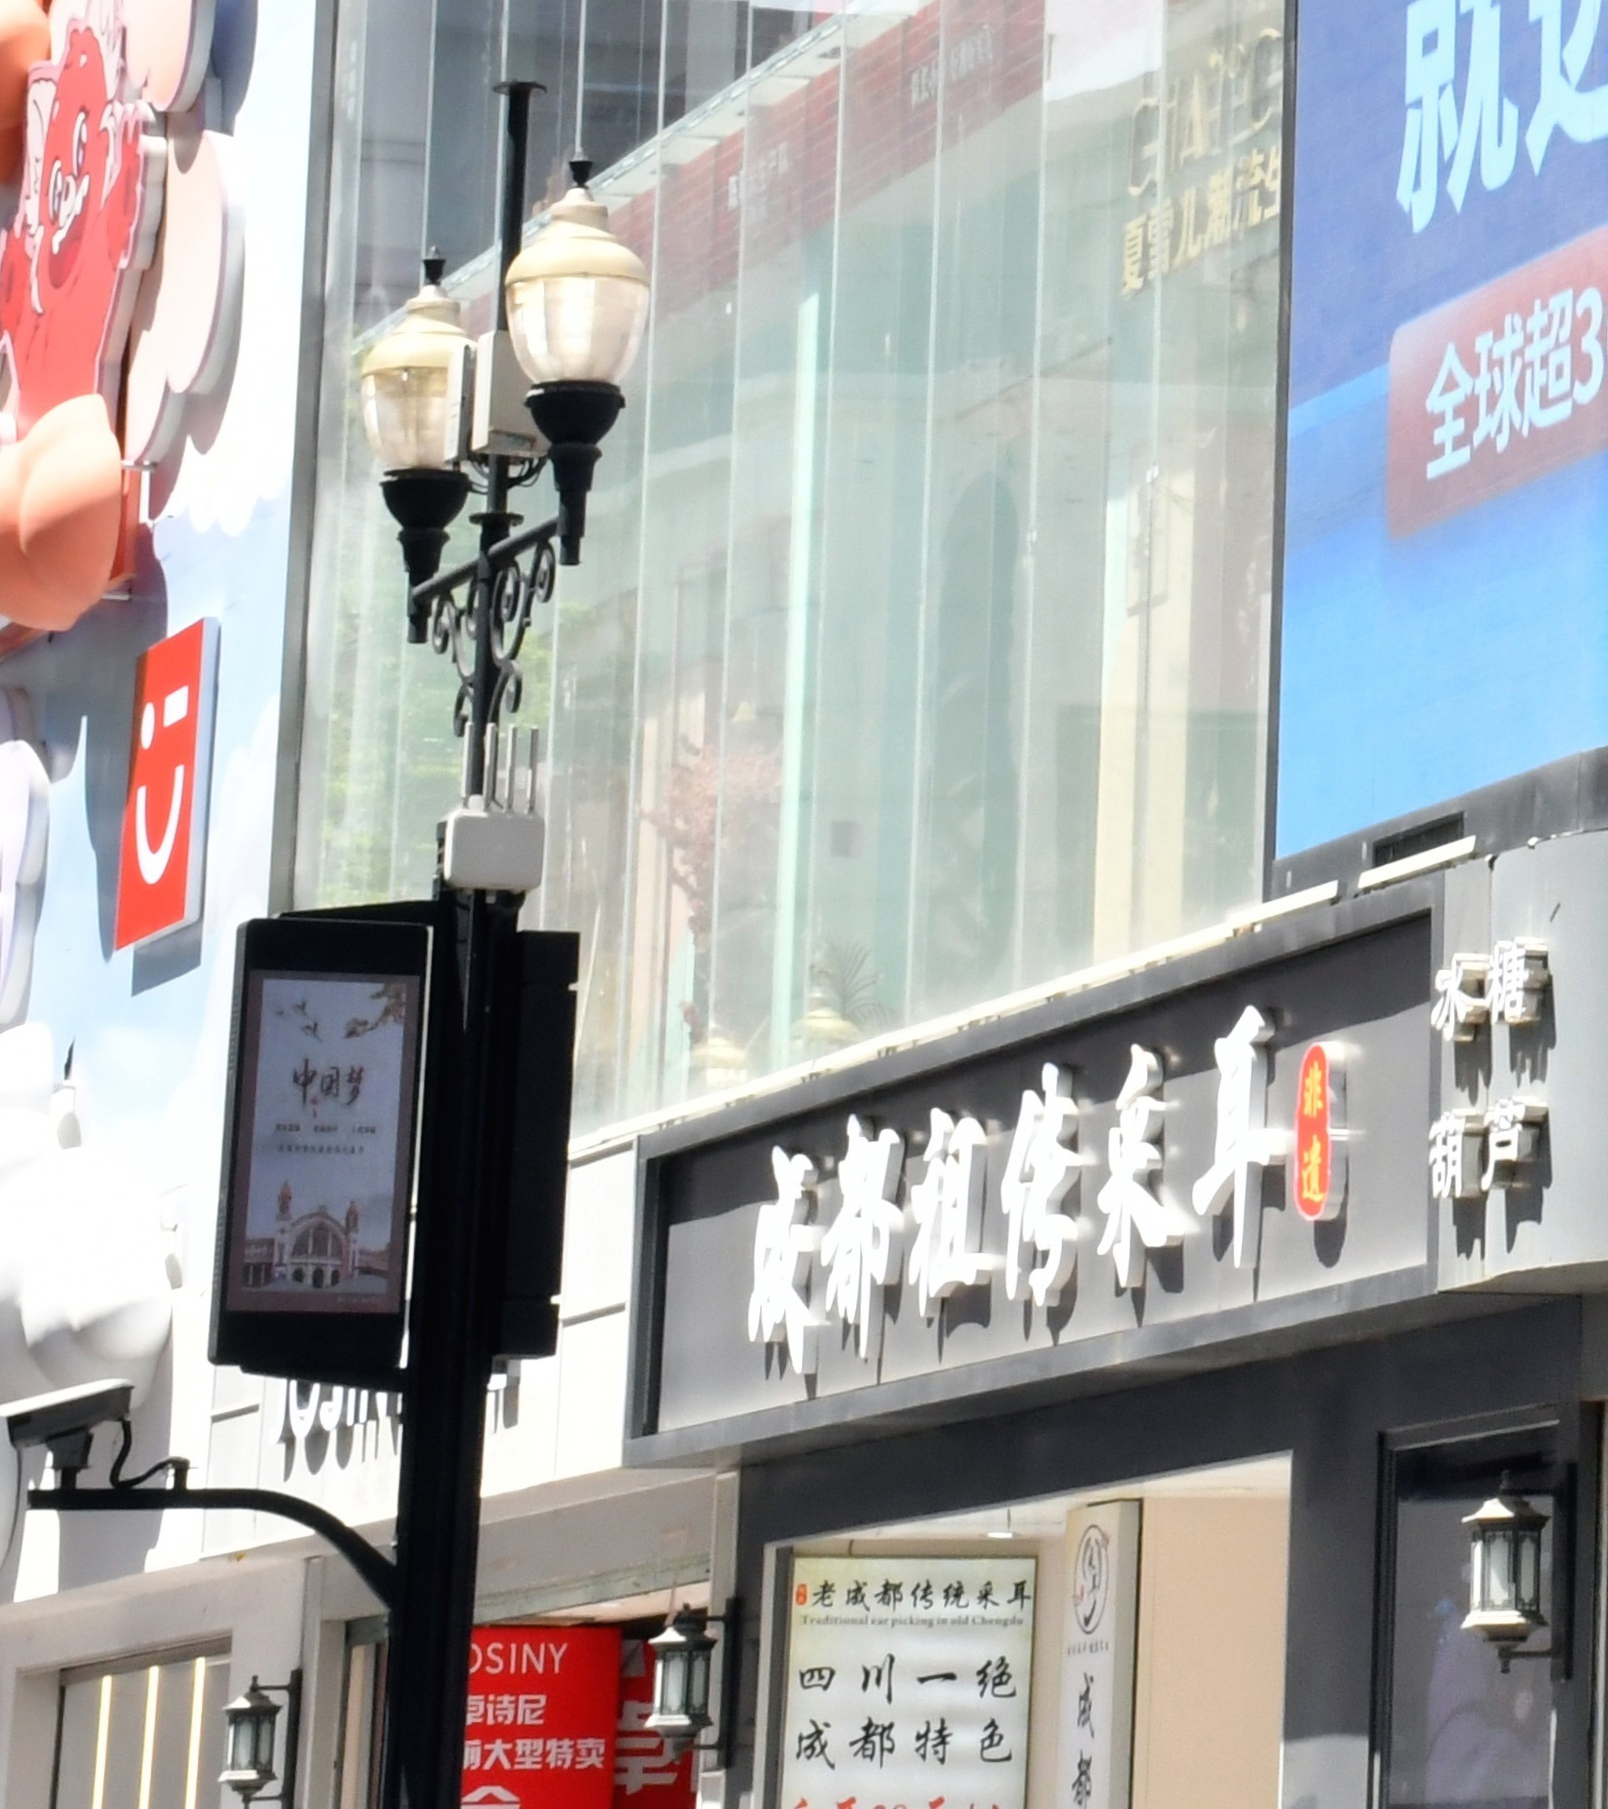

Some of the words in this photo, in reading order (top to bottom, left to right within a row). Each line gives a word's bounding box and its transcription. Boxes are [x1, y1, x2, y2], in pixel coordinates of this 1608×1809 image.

[292, 1058, 364, 1106] 中国梦
[812, 1579, 1032, 1612] 老成都传统采耳
[801, 1614, 868, 1626] Traditional
[871, 1617, 890, 1626] ear
[891, 1614, 935, 1629] picking
[936, 1615, 949, 1626] in
[950, 1615, 969, 1627] old
[971, 1615, 1024, 1628] Chengdu
[798, 1653, 1017, 1705] 四川一绝
[796, 1719, 1013, 1769] 成都特色
